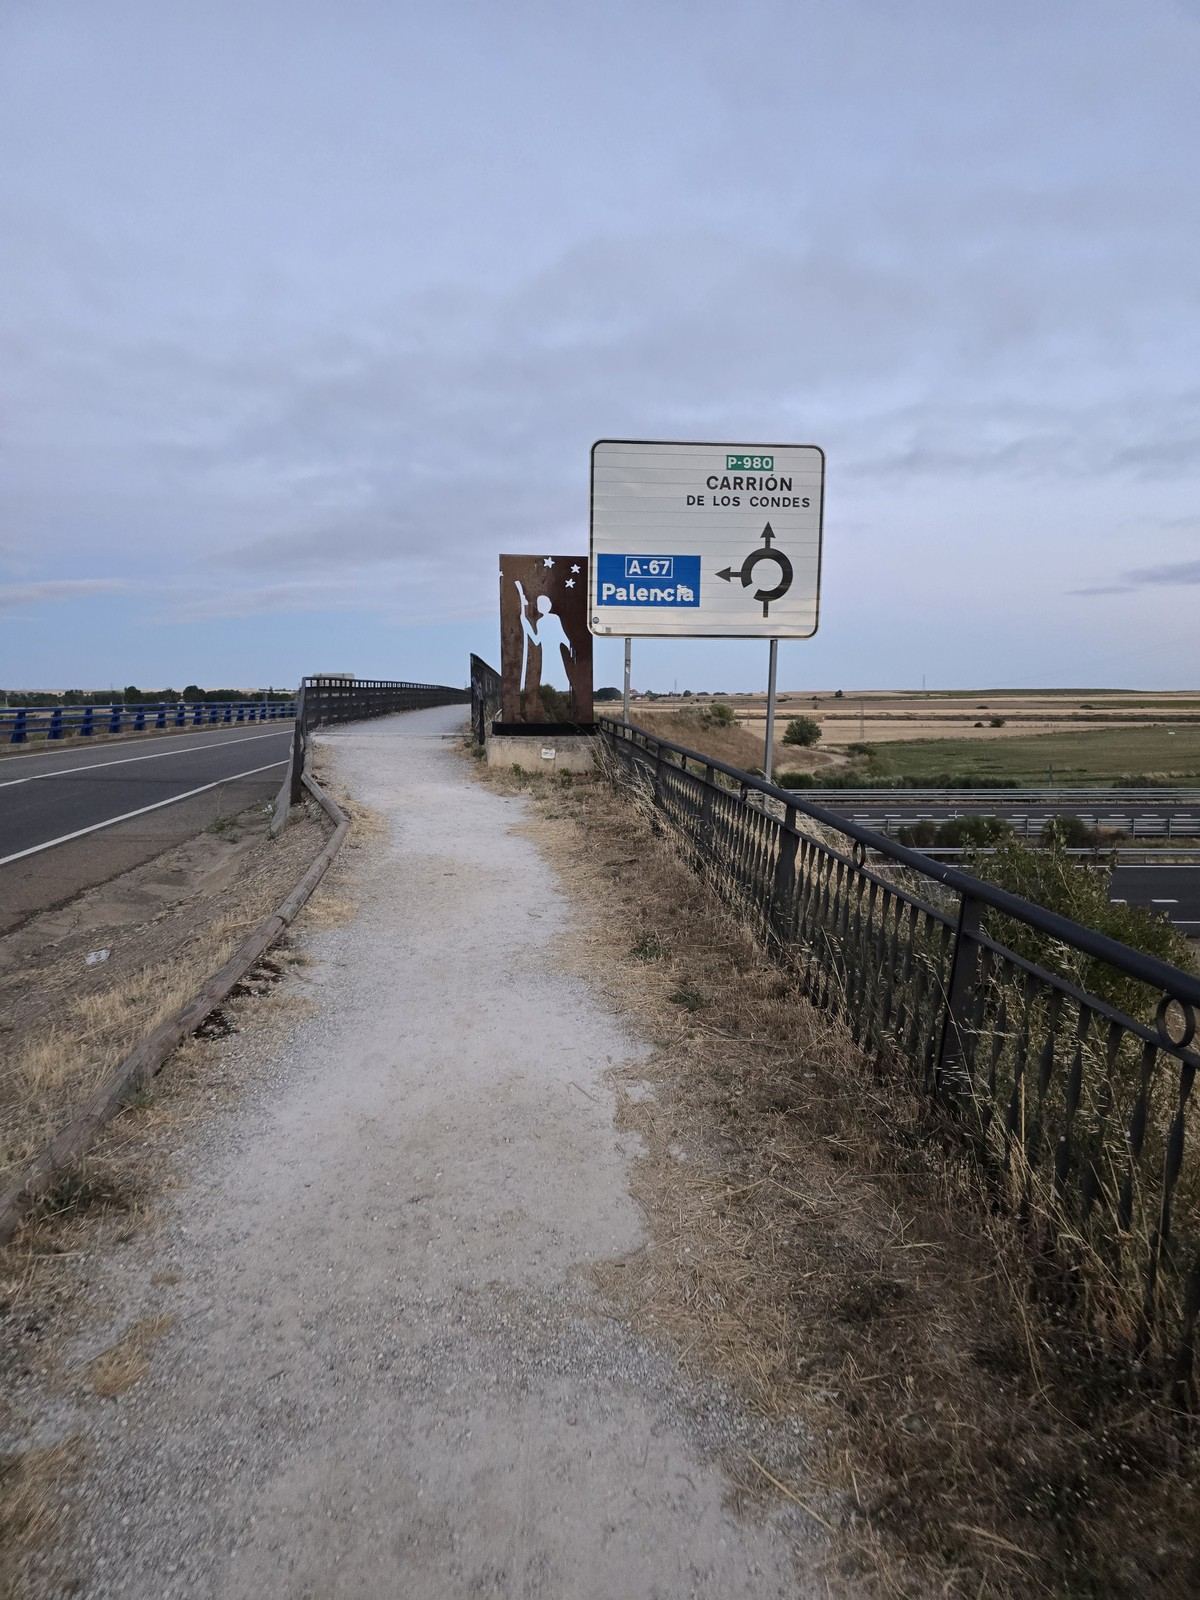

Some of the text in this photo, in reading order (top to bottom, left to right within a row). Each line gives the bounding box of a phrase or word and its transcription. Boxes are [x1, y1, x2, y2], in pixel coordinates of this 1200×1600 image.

[727, 457, 772, 469] P-980
[706, 473, 793, 492] CARRIÓN
[687, 495, 811, 508] DE LOS CONDES
[628, 559, 670, 575] A-67
[601, 583, 694, 603] Palencia
